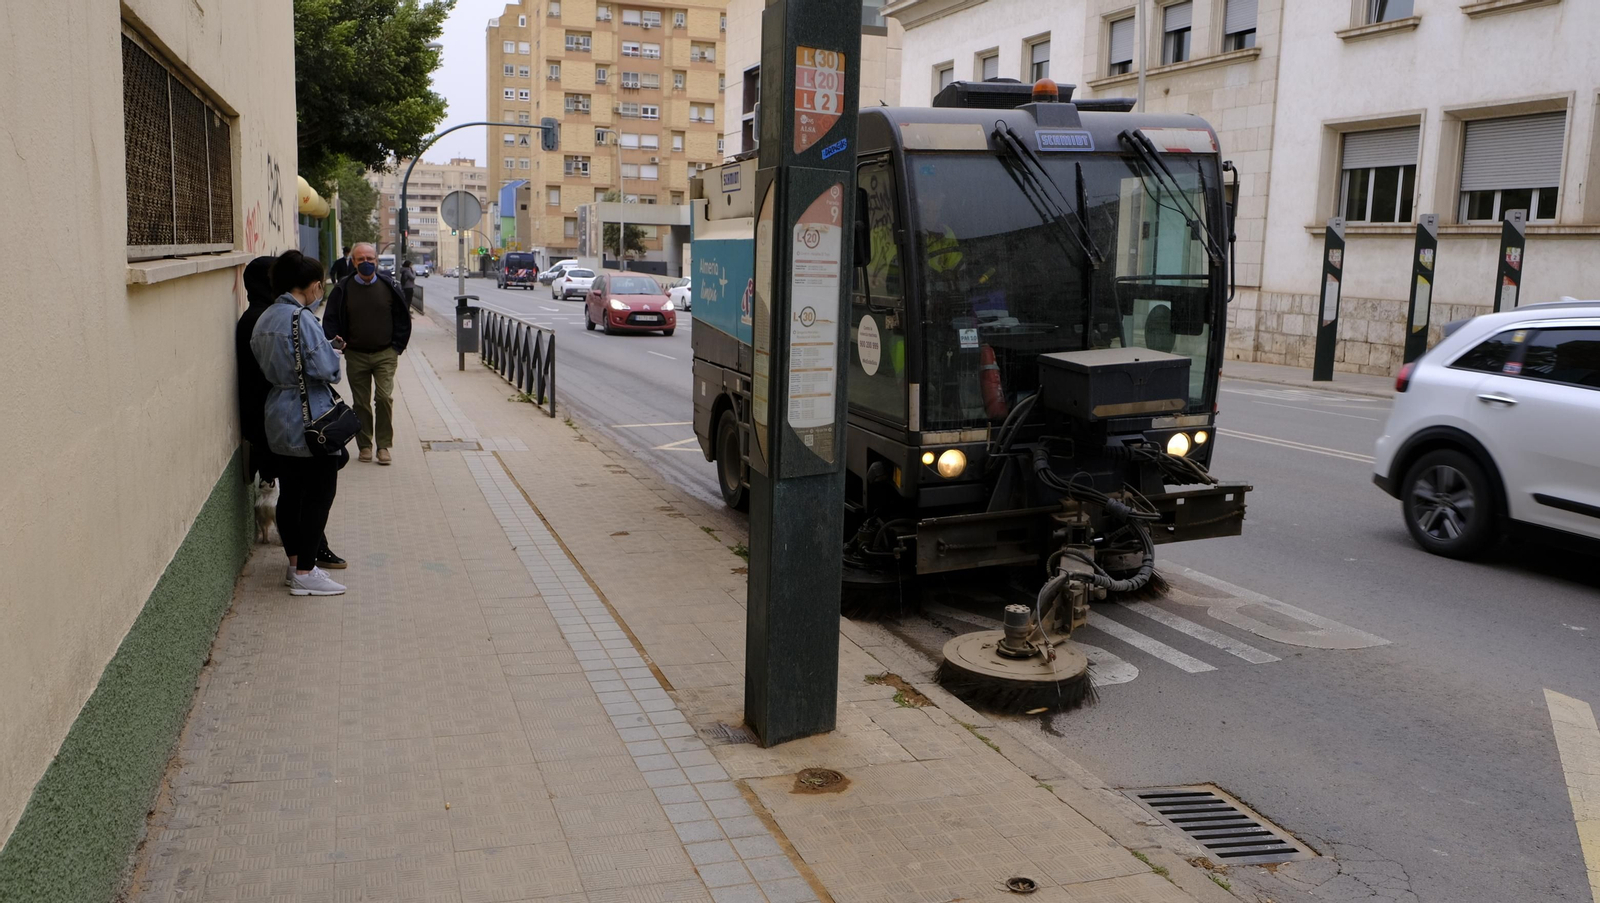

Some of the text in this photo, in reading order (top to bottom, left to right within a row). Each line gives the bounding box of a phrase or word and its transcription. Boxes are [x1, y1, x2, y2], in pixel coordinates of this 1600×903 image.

[804, 50, 835, 69] L 30
[803, 71, 835, 90] L 20
[803, 92, 830, 111] L 2
[1041, 134, 1089, 146] SCHMIDT
[830, 206, 839, 223] 9
[796, 232, 817, 244] L 20
[699, 257, 719, 276] Almería
[793, 311, 813, 322] L 30
[298, 374, 306, 395] LOLA
